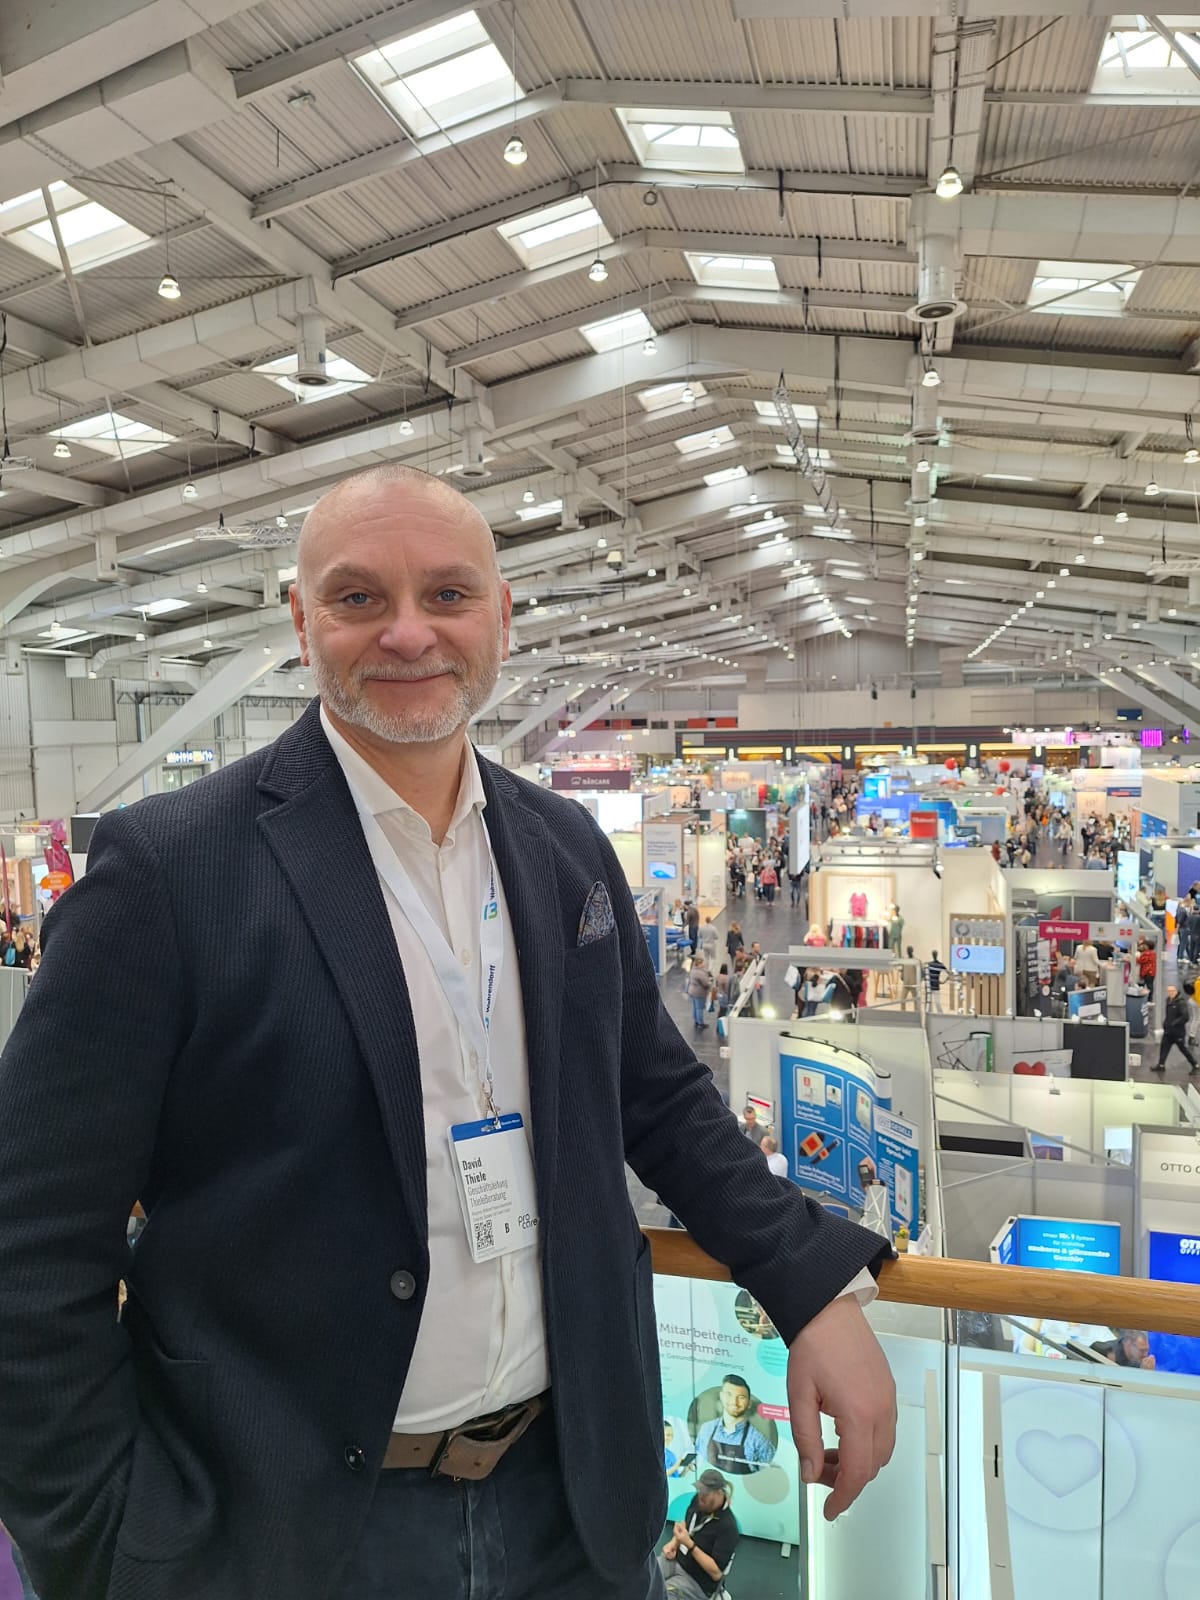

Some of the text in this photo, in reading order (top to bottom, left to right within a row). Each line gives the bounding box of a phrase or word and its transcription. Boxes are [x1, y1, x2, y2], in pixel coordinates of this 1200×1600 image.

[484, 964, 497, 1014] Wahrendorff
[462, 1157, 482, 1171] David
[1160, 1162, 1192, 1173] OTTO
[465, 1171, 487, 1185] Thiele
[504, 1222, 510, 1234] B
[660, 1322, 751, 1347] Mitarbeitende,
[660, 1338, 734, 1358] ternehmen.
